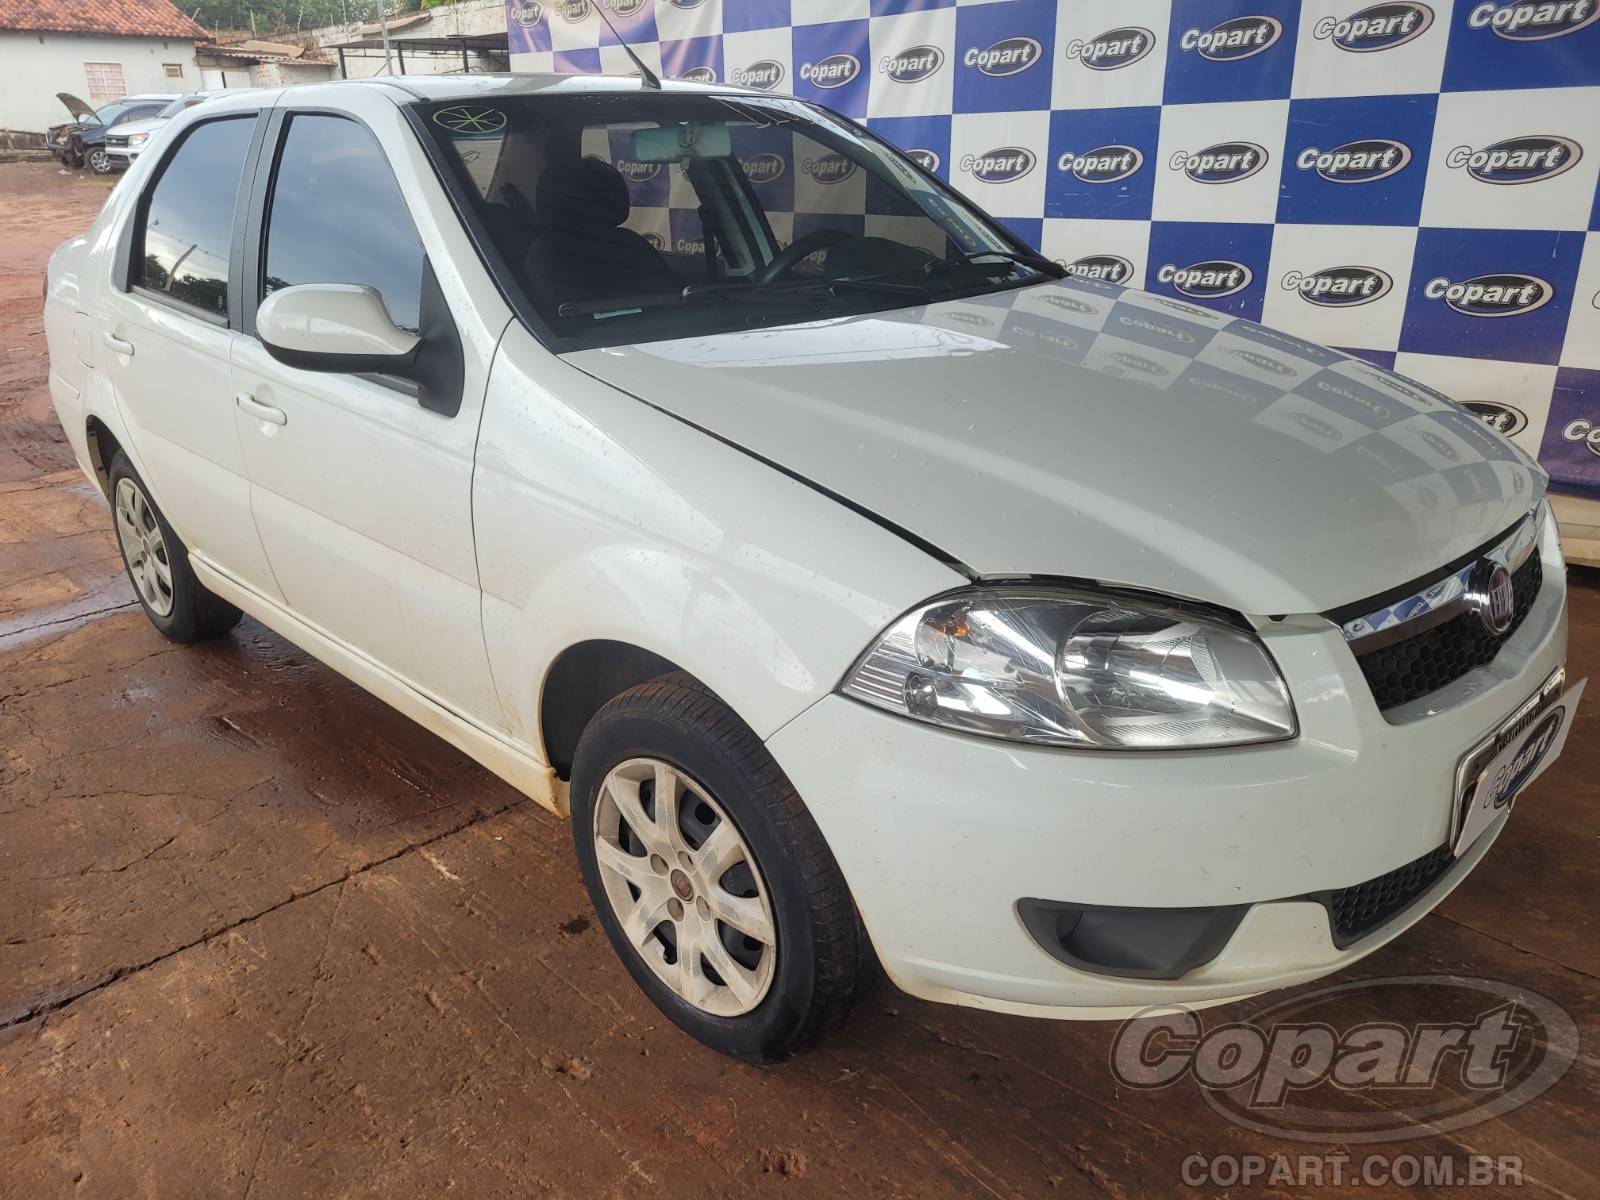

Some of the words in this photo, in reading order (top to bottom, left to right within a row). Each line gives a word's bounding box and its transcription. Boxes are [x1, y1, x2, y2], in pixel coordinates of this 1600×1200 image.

[511, 6, 538, 21] Copart
[555, 1, 586, 16] Copart
[1468, 0, 1590, 32] Copart
[1181, 20, 1269, 52] Copart
[1313, 13, 1418, 41] Copart
[964, 43, 1032, 67] Copart
[1066, 34, 1144, 60] Copart
[801, 62, 851, 82] Copart
[879, 52, 935, 75] Copart
[731, 66, 777, 87] Copart
[617, 159, 653, 175] Copart
[742, 160, 779, 176] opart
[801, 158, 848, 176] Copart
[960, 153, 1026, 175] Copart
[1058, 151, 1134, 175] Copart
[1169, 147, 1254, 176] Copart
[1296, 144, 1396, 175] Copart
[1446, 144, 1563, 174] Copart
[677, 239, 705, 254] Copa
[1157, 264, 1242, 290] Copart
[1281, 270, 1377, 297] Copart
[1424, 277, 1537, 306] Copart
